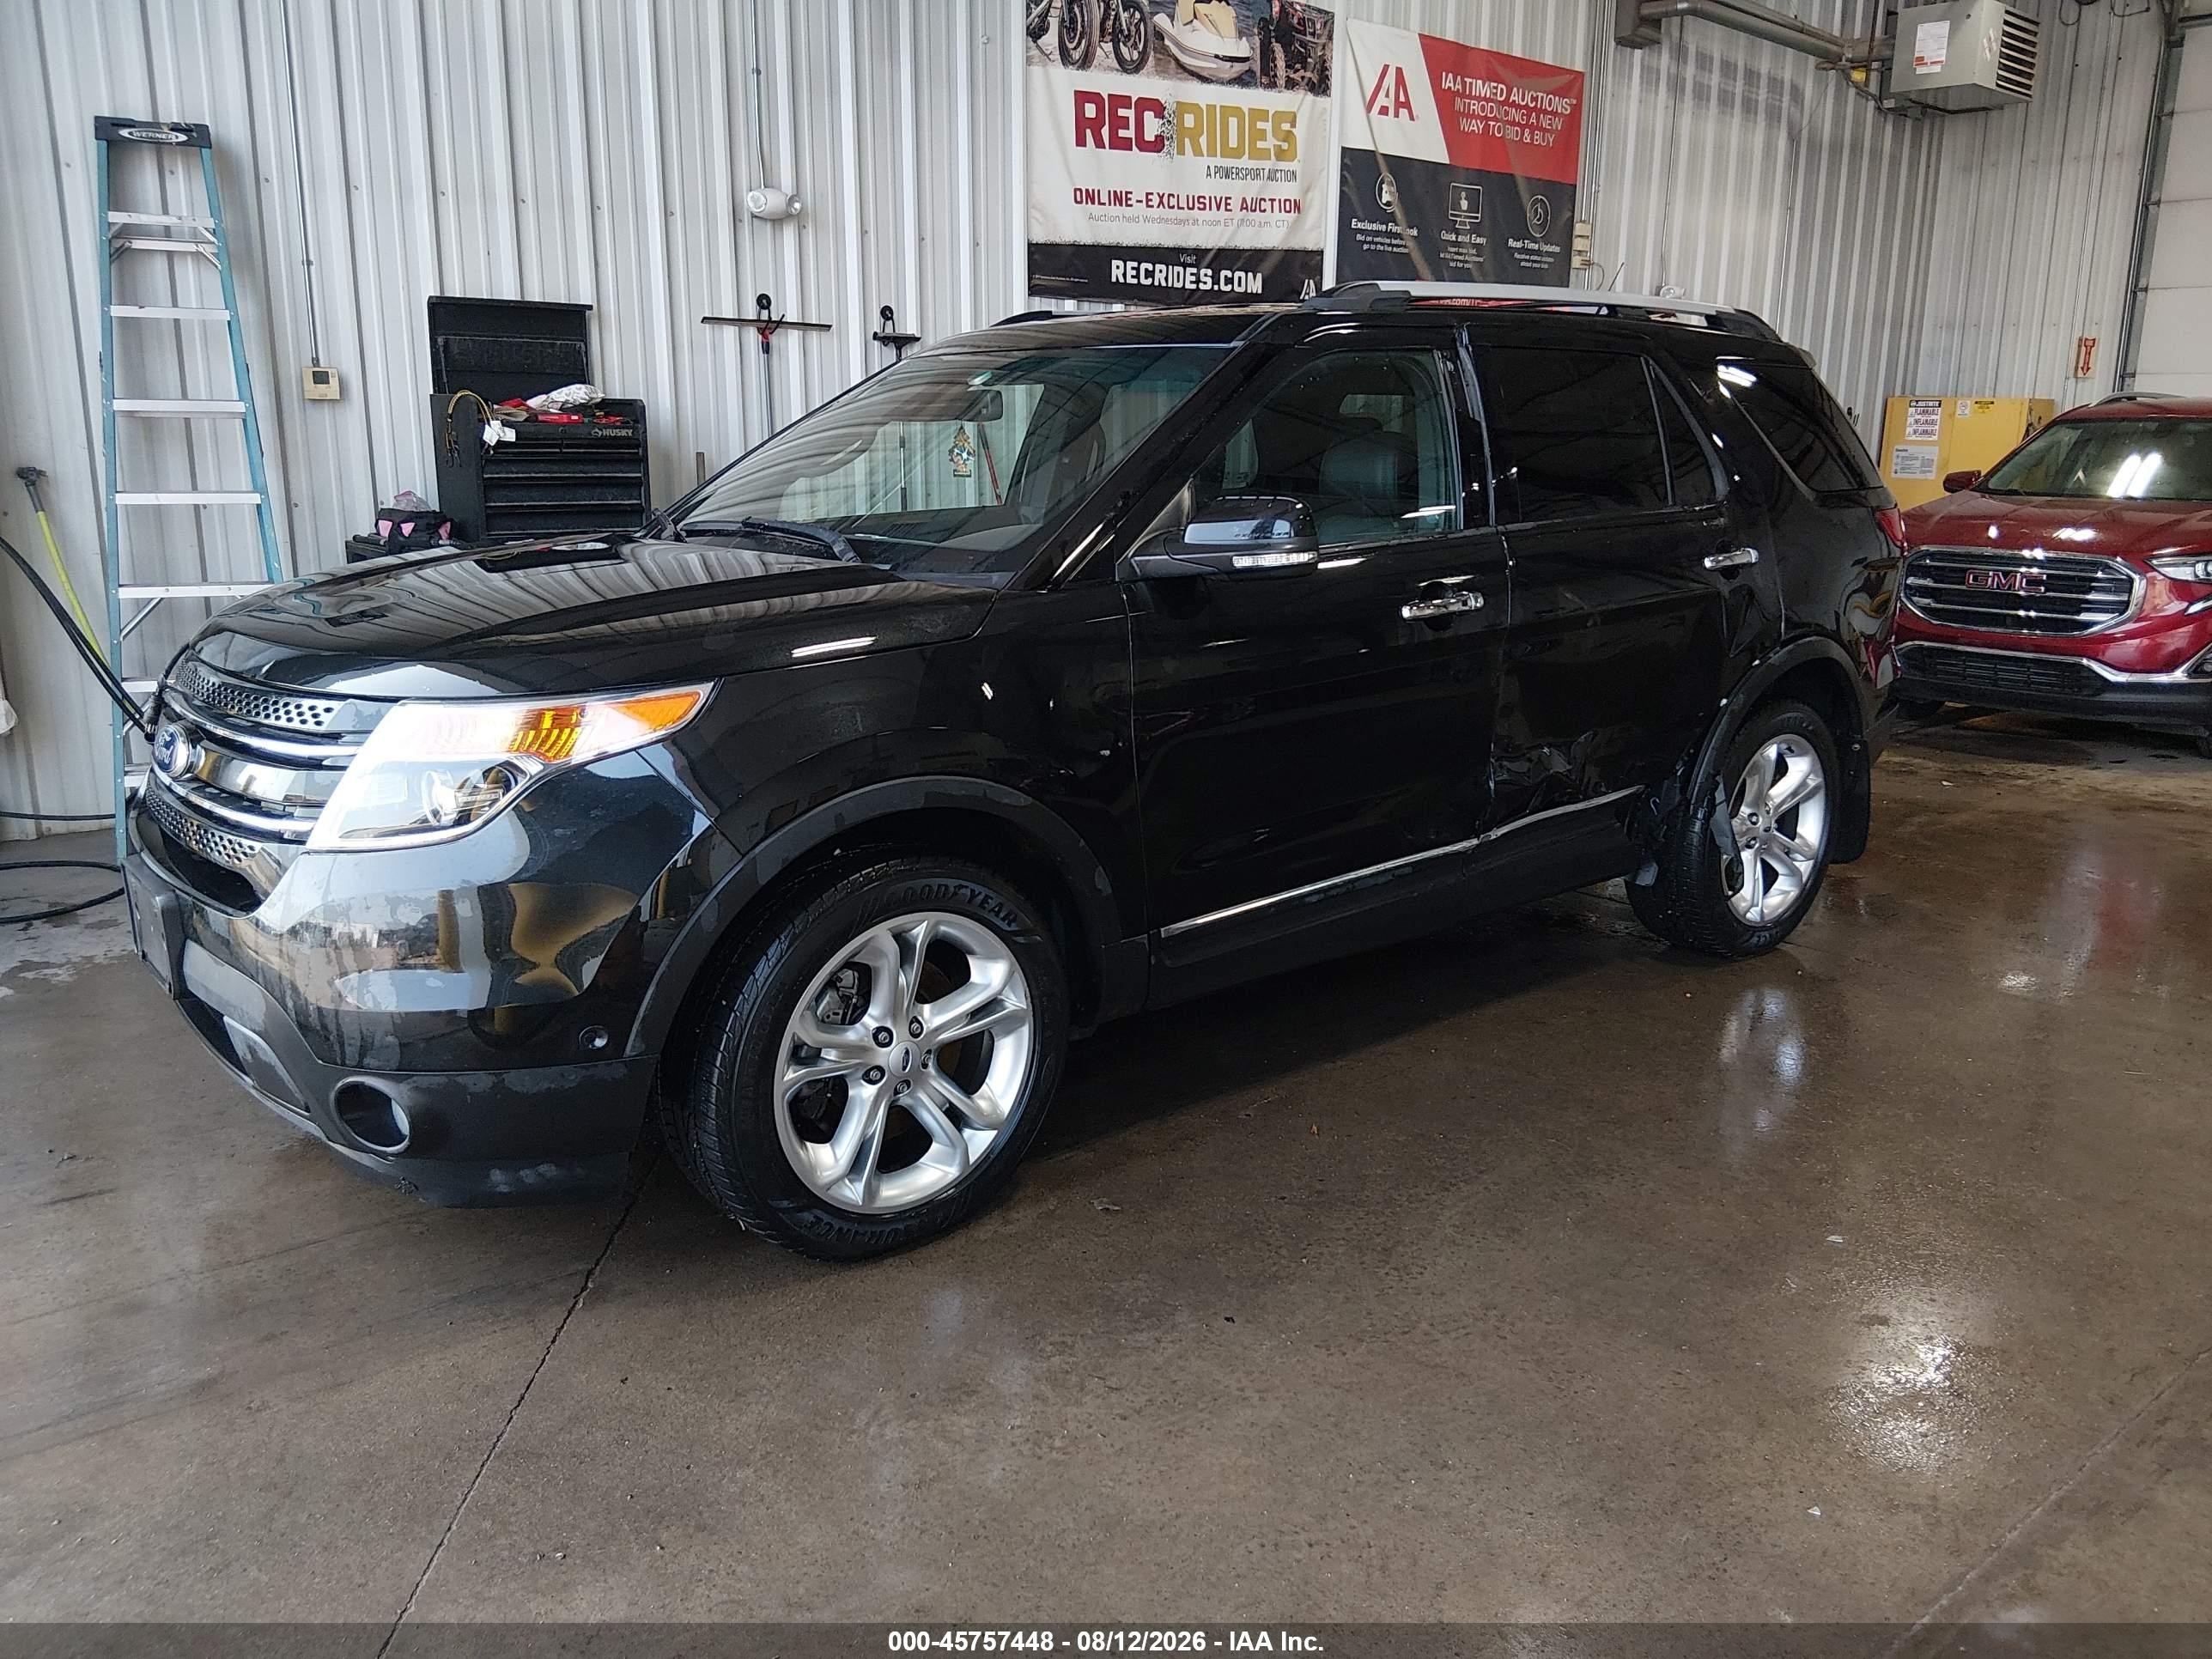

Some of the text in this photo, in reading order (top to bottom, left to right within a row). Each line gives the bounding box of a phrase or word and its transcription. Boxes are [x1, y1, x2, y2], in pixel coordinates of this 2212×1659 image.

[1442, 71, 1462, 94] IAA
[1464, 77, 1507, 101] TIMED
[1455, 96, 1563, 131] INTRODUCING A NEW
[132, 131, 177, 140] WERNER
[1175, 100, 1298, 162] RIDES
[1459, 116, 1555, 147] WAY TO BID & BUY
[1206, 165, 1297, 182] A POWERSPORT AUCTION
[1073, 187, 1302, 214] ONLINE-EXCLUSIVE AUCTION
[1088, 212, 1120, 222] Auction
[1121, 213, 1139, 223] held
[1142, 215, 1190, 227] Wednesdays
[1191, 217, 1200, 227] at
[1202, 218, 1222, 227] noon
[1224, 218, 1235, 227] ET
[1275, 220, 1290, 229] CT)
[1351, 218, 1386, 232] Exclusive
[1441, 230, 1486, 246] Quick and Easy
[1508, 238, 1561, 252] Real-Time Updates
[1179, 253, 1196, 264] Visit
[1111, 259, 1263, 294] RECRIDES.COM
[603, 428, 633, 437] HUSKY
[1965, 569, 2047, 593] GMC
